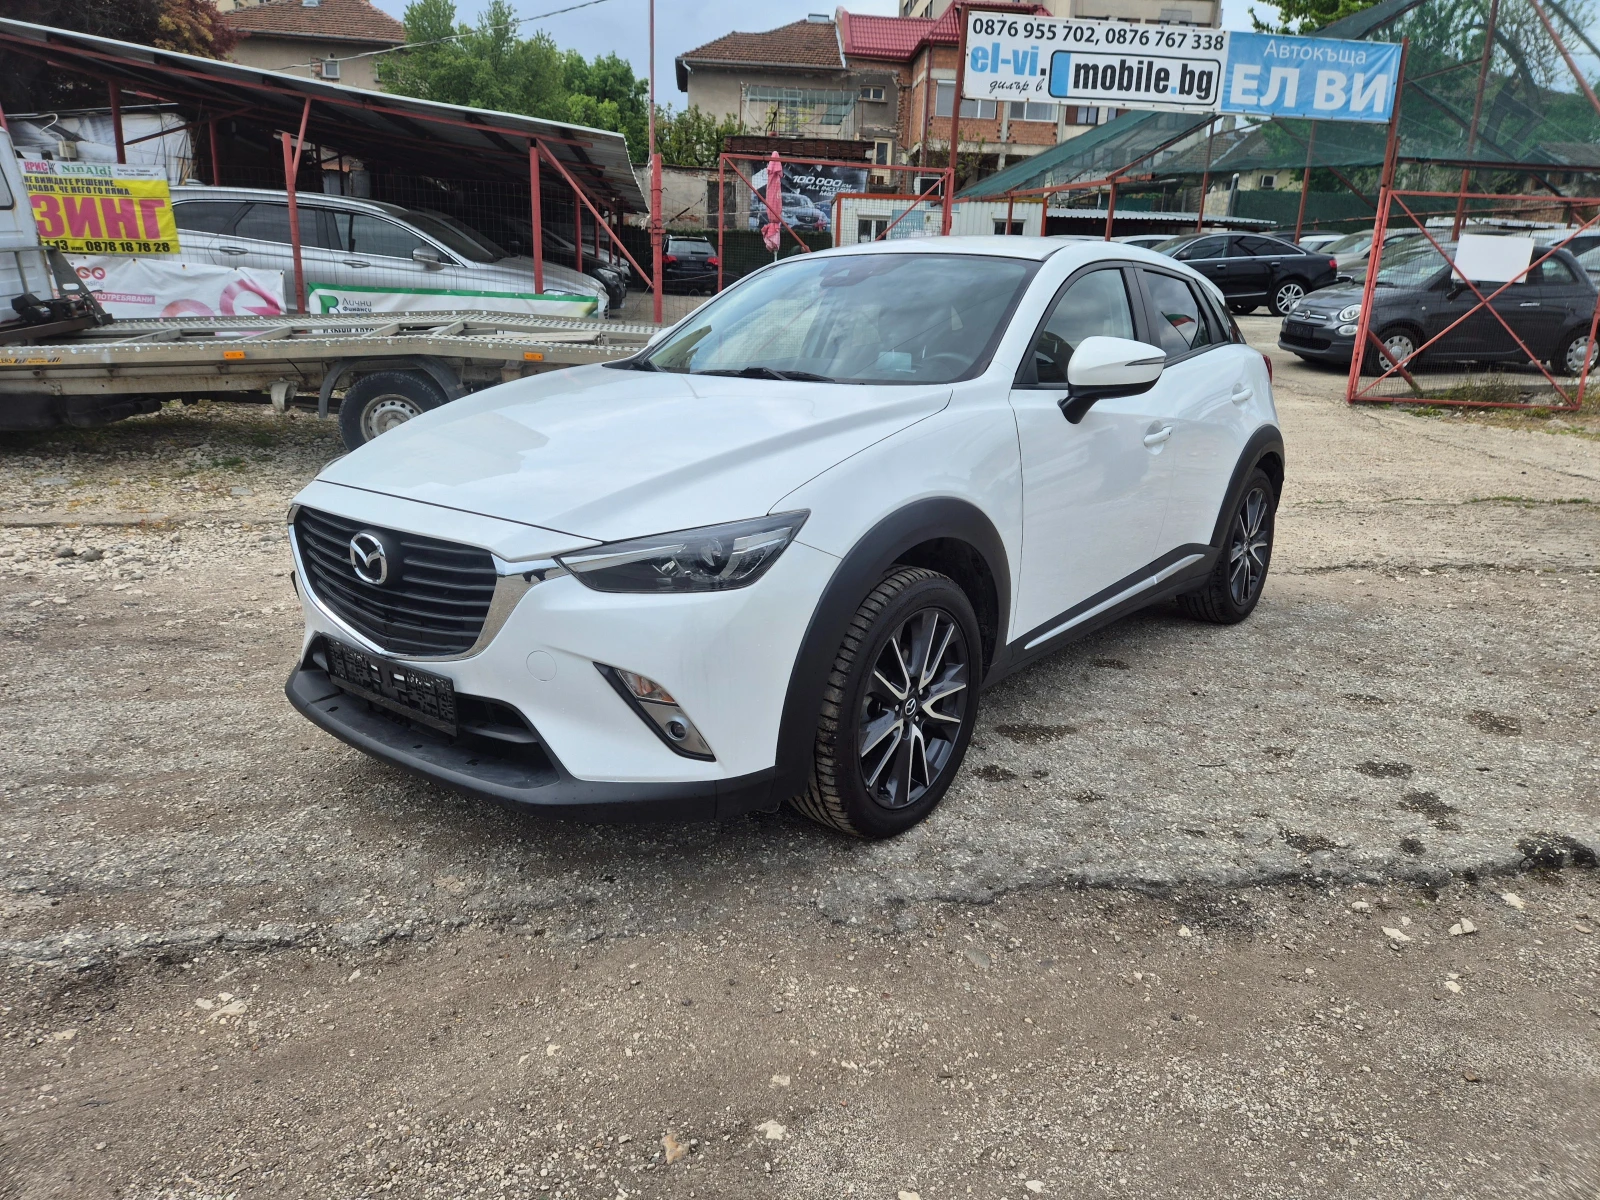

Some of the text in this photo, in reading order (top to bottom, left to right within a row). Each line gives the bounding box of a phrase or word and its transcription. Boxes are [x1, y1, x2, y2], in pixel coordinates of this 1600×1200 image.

[972, 18, 1225, 51] 0876 955 702, 0876 767 338
[1263, 39, 1367, 67] Автокъща
[1073, 59, 1213, 100] mobile.bg
[988, 80, 1030, 94] дилър
[1229, 63, 1388, 113] ЕЛ ВИ
[34, 176, 74, 185] ВИЖДАТЕ
[792, 175, 816, 184] 100
[815, 177, 842, 187] 000
[71, 186, 92, 194] НЕГО
[30, 194, 165, 239] ЗИНГ
[85, 241, 117, 252] 0878
[119, 242, 134, 252] 18
[135, 242, 151, 252] 78
[153, 242, 170, 252] 28
[342, 297, 372, 307] Лични
